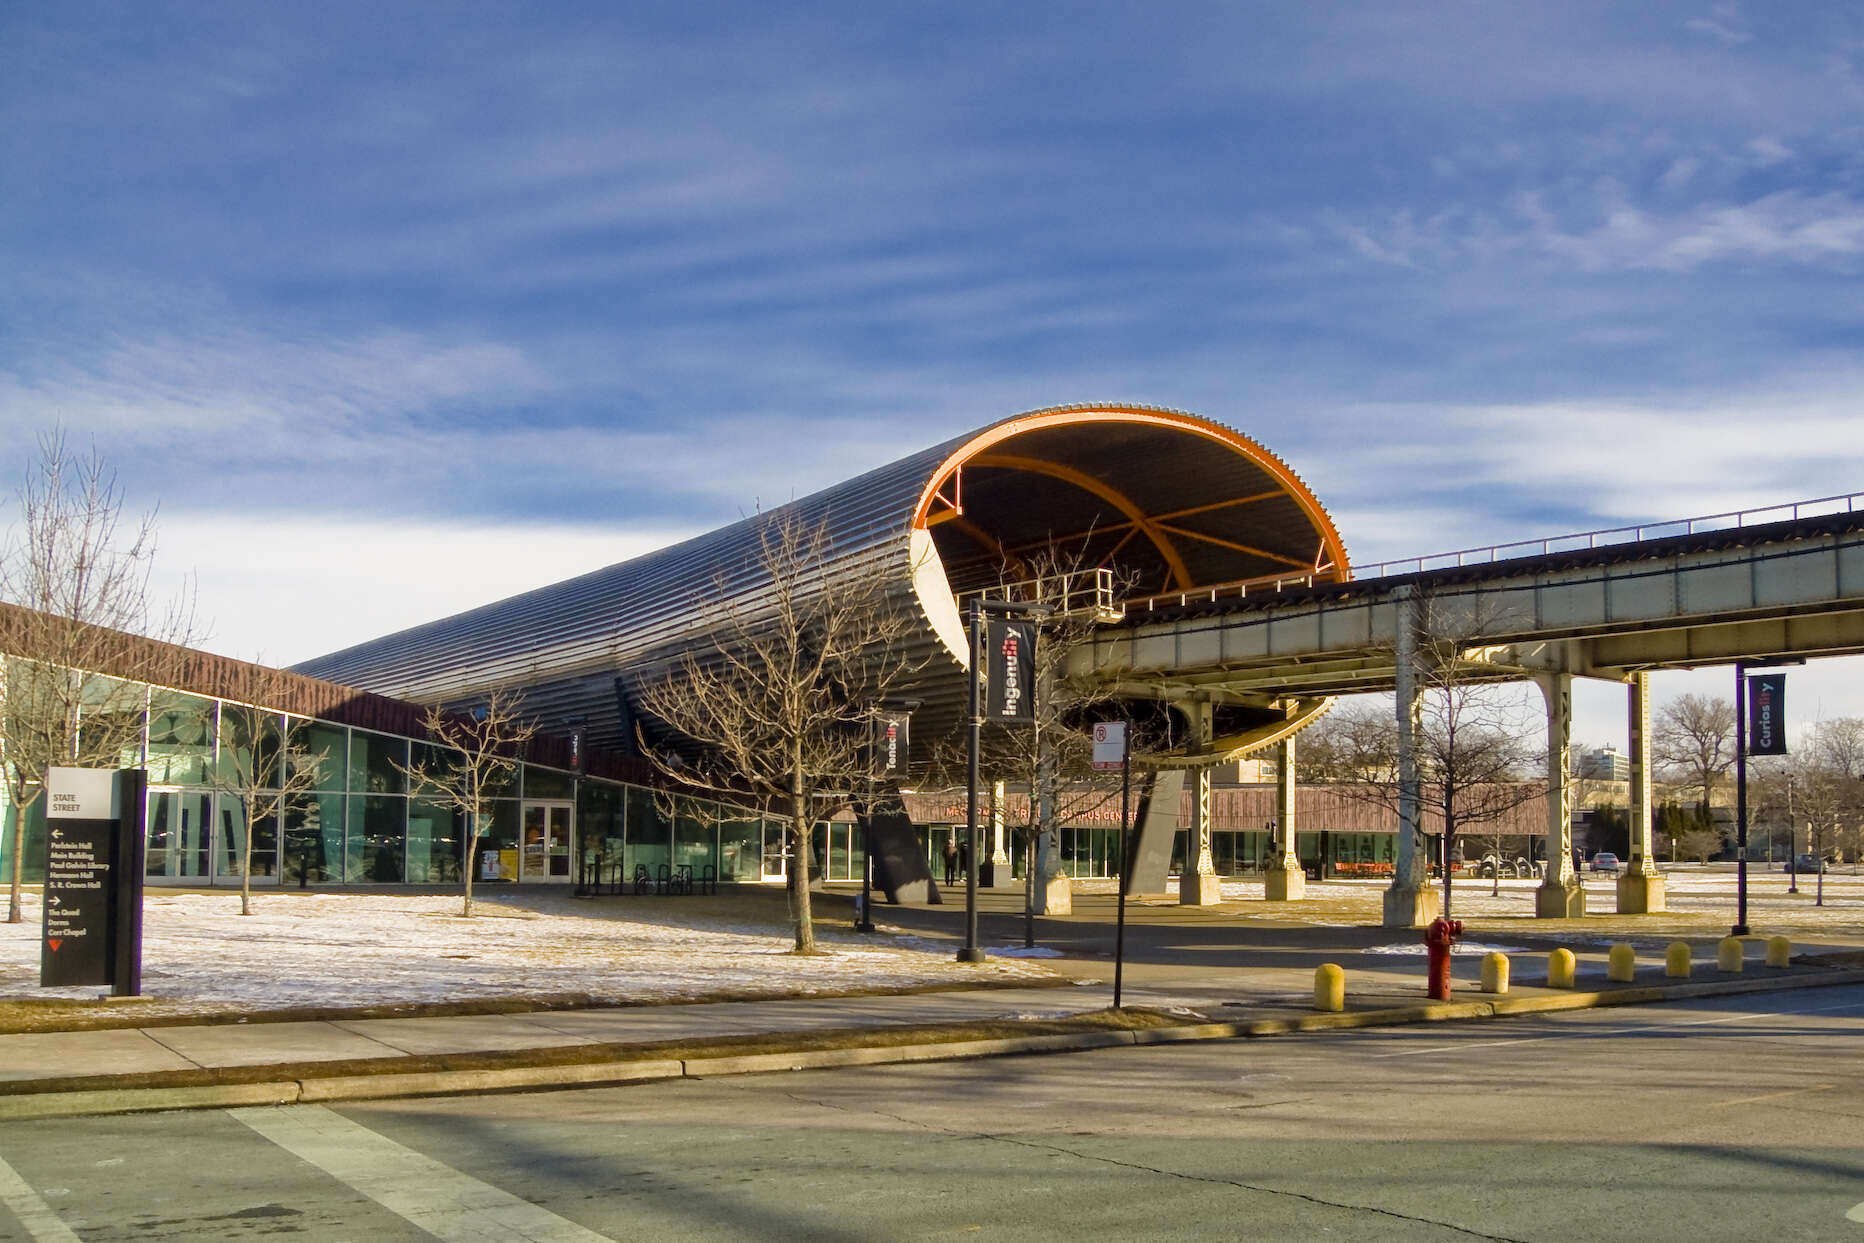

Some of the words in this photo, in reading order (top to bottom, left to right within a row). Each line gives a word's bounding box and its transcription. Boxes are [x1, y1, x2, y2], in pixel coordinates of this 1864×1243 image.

[53, 793, 76, 802] STATE
[52, 803, 80, 812] STREET
[78, 841, 93, 850] Hall
[68, 851, 95, 861] Building
[80, 871, 94, 879] Hall
[87, 881, 102, 889] Hall
